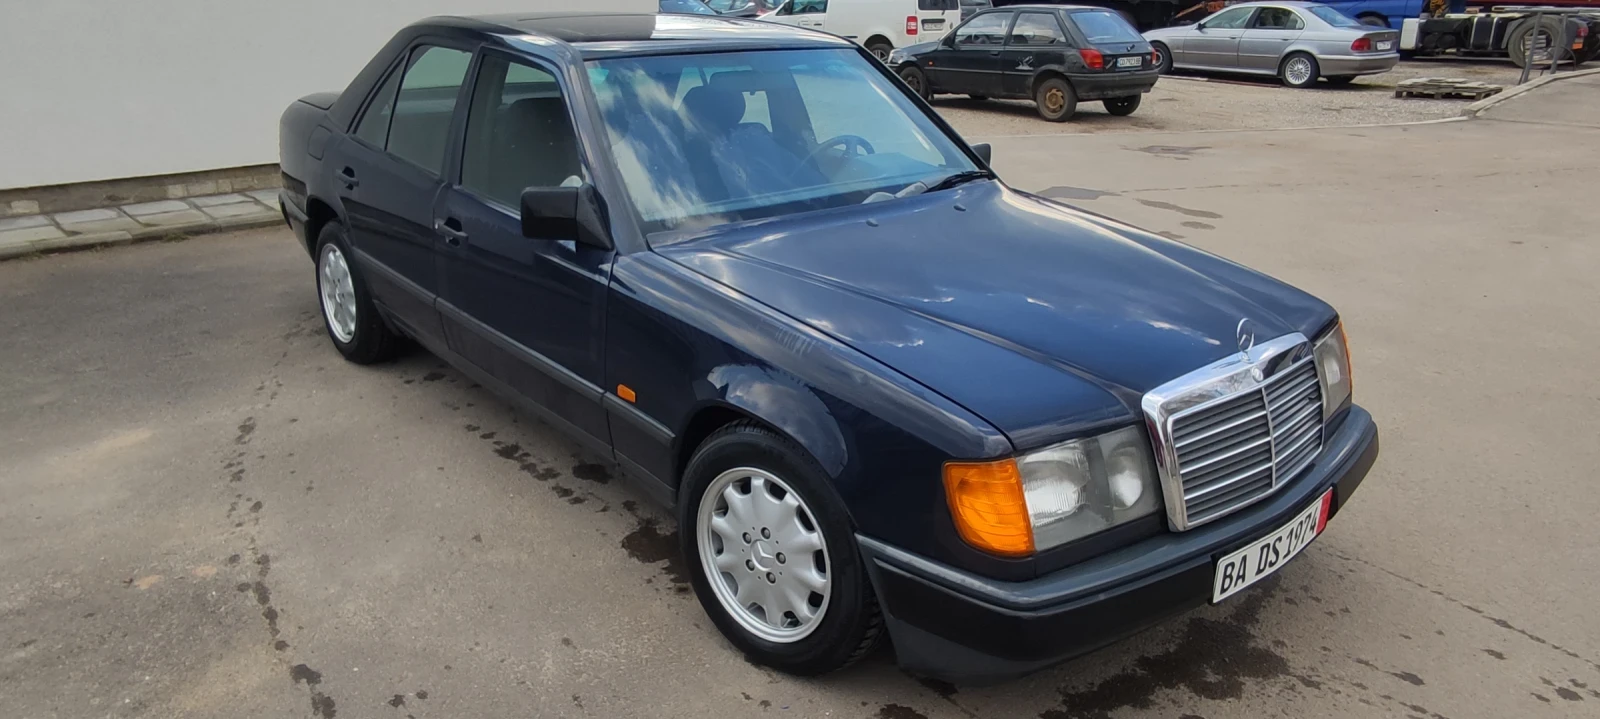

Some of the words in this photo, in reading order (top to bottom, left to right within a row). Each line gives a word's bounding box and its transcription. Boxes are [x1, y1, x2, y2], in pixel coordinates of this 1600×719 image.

[1220, 554, 1247, 595] BA
[1255, 535, 1282, 576] DS
[1282, 506, 1318, 559] 1974
